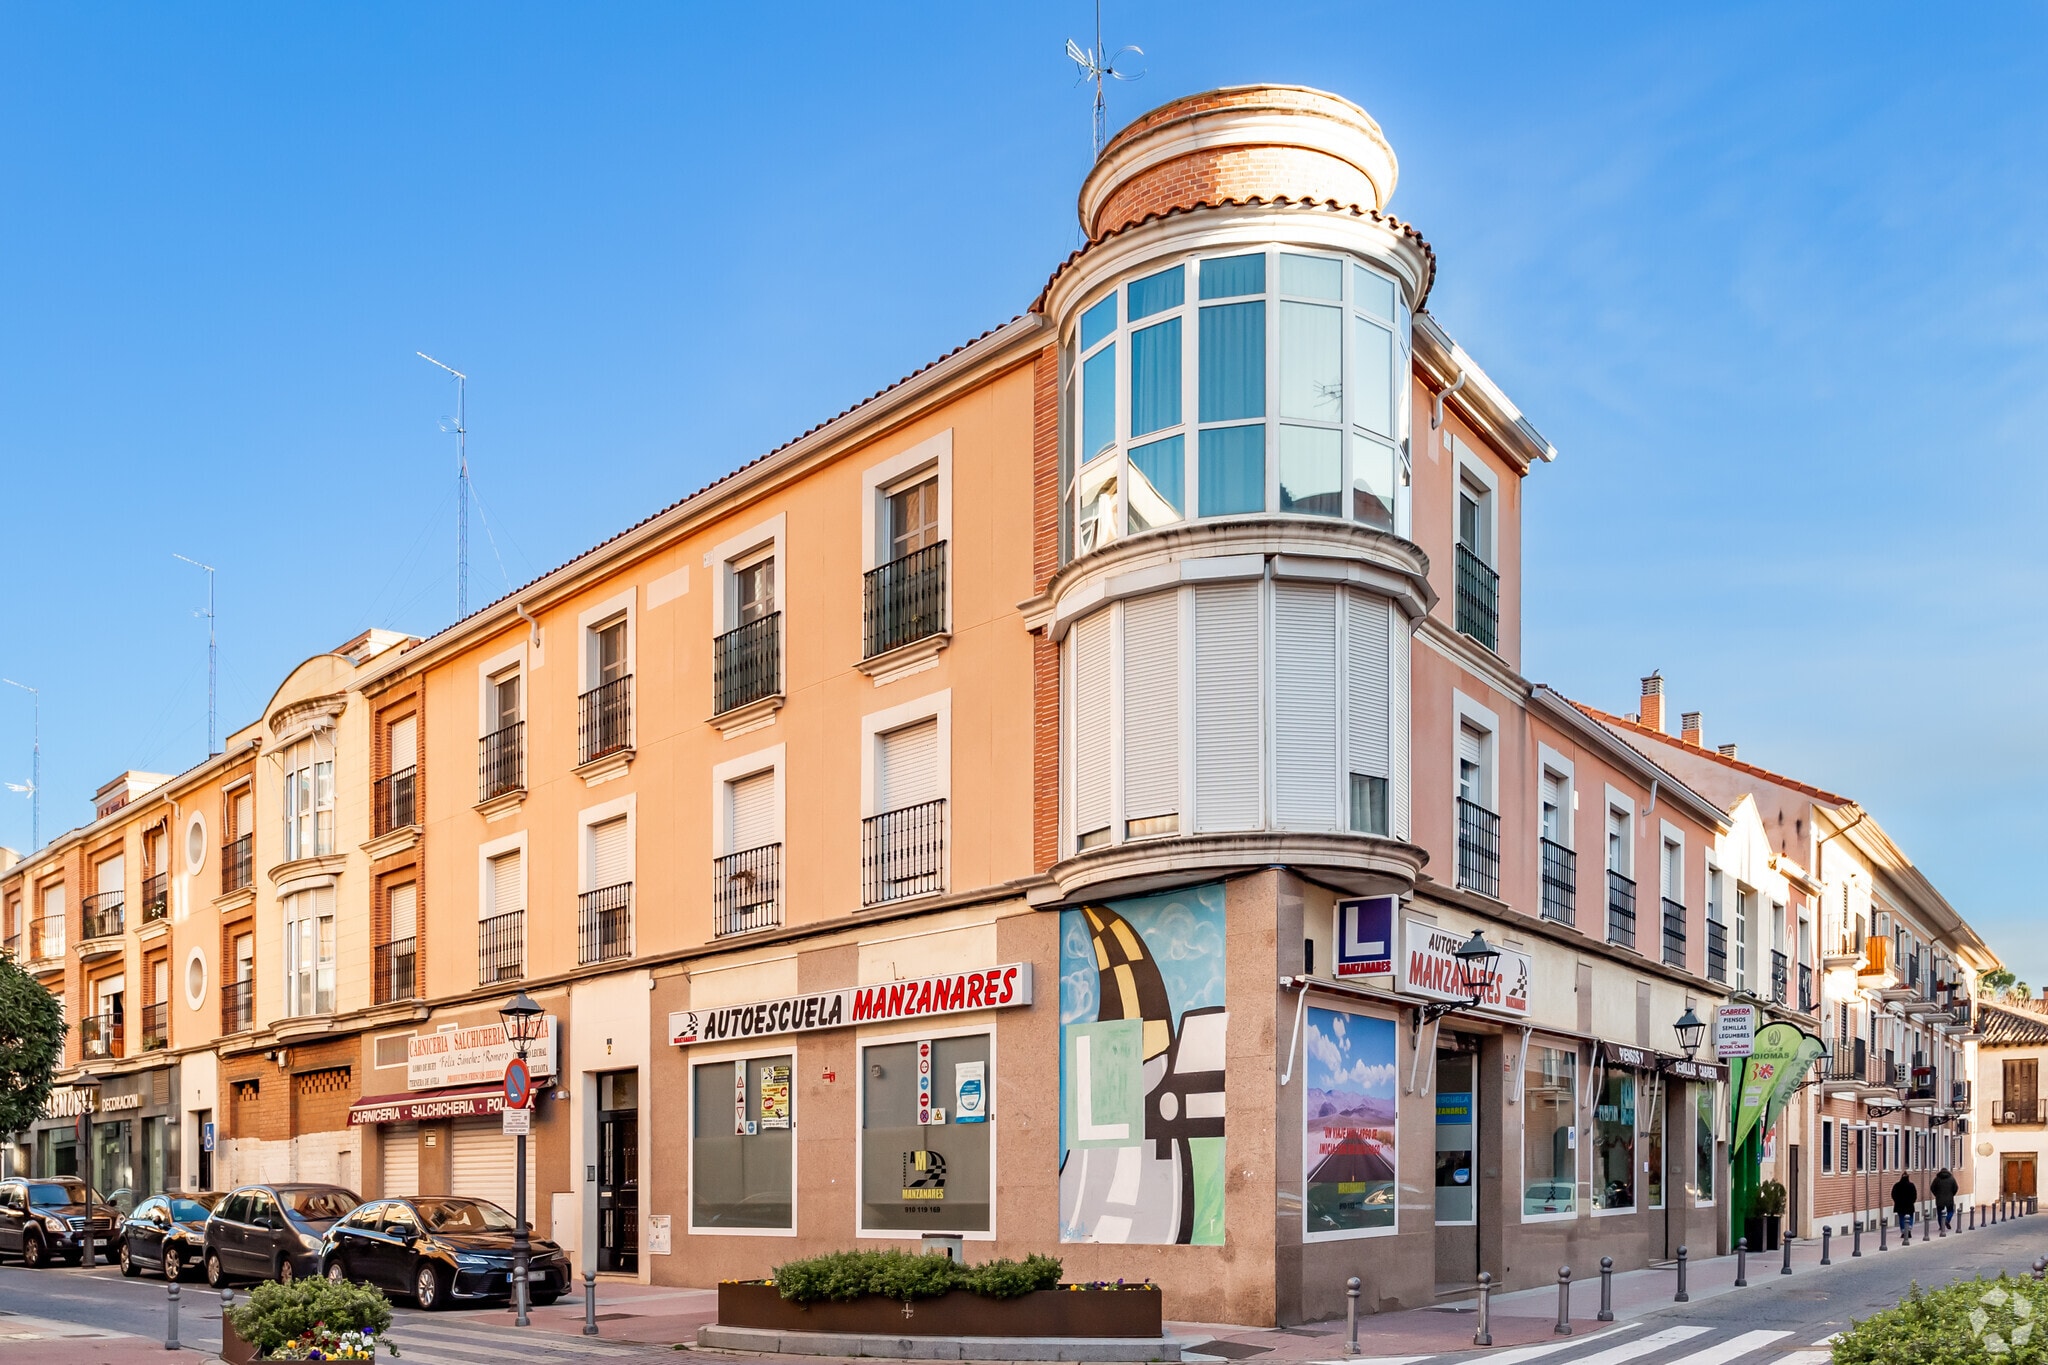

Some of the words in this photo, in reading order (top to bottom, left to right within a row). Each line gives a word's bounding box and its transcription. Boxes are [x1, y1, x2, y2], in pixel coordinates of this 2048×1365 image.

[1345, 907, 1384, 957] L
[1338, 961, 1391, 975] MANZANARES
[852, 968, 1017, 1021] MANZANARES
[704, 995, 842, 1040] AUTOESCUELA
[1720, 1008, 1750, 1016] CABRERA
[409, 1036, 448, 1057] CARNICERIA
[454, 1026, 506, 1050] SALCHICHERIA
[607, 1045, 612, 1055] 2
[101, 1093, 138, 1112] DECORACION
[352, 1109, 400, 1124] CARNICERIA
[411, 1100, 475, 1118] SALCHICHERIA
[902, 1188, 944, 1200] MANZANARES
